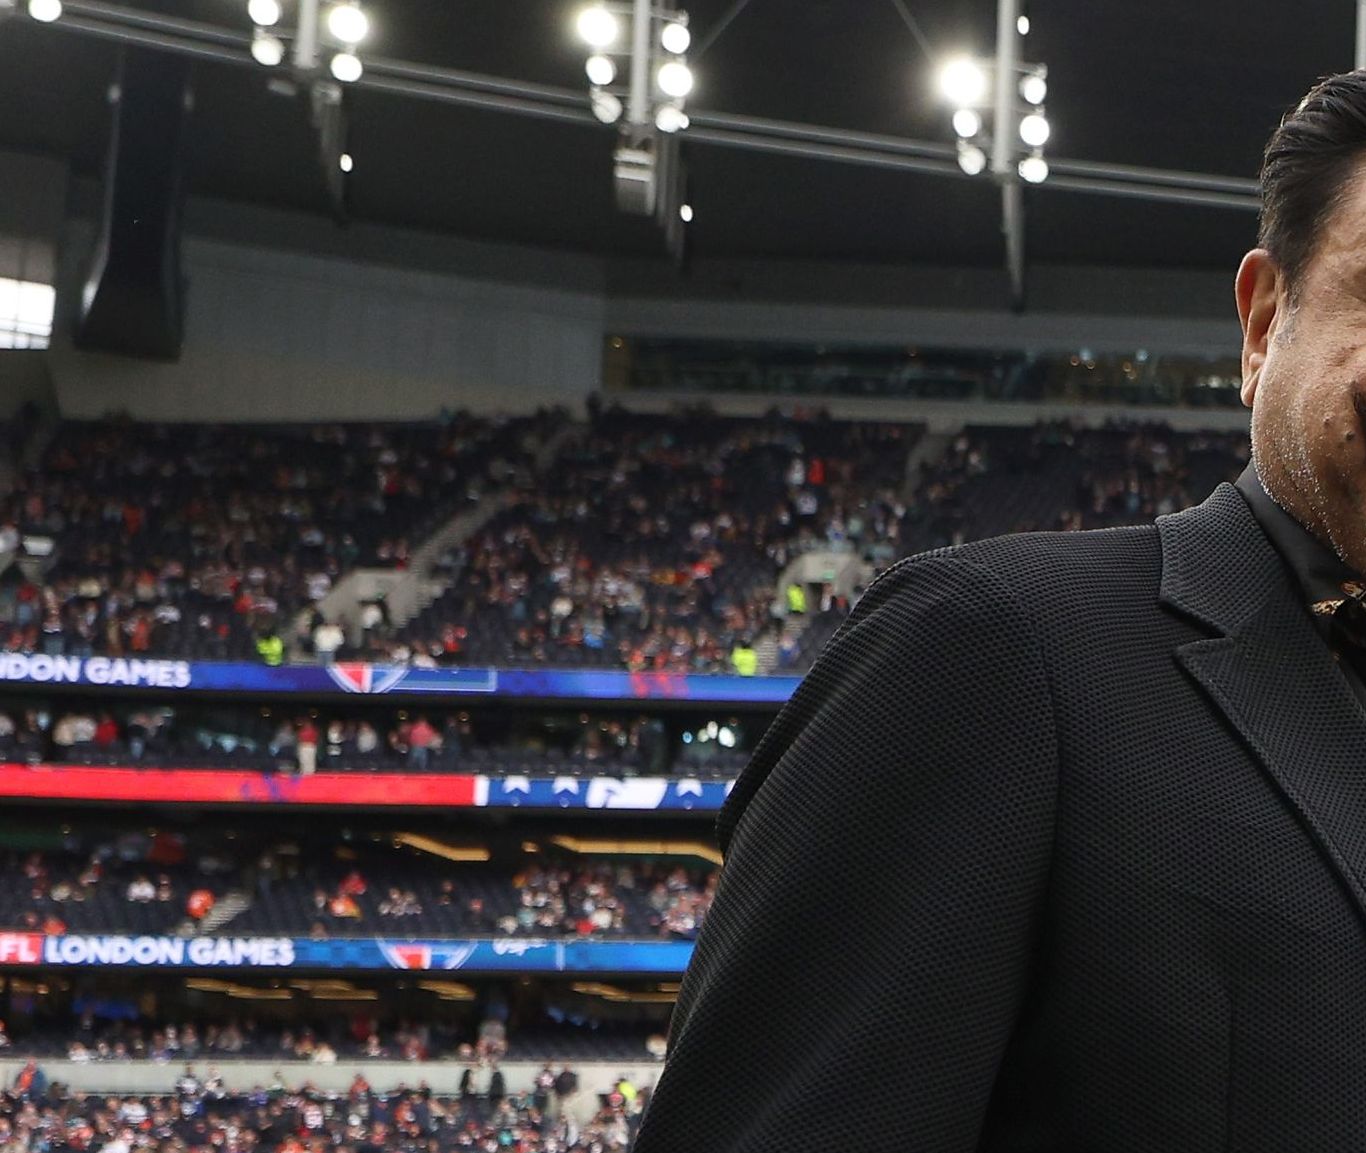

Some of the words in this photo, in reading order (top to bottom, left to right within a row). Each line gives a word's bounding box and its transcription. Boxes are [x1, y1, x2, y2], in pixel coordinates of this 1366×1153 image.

[0, 653, 80, 682] DON
[85, 656, 192, 688] GAMES
[44, 934, 184, 965] LONDON
[188, 936, 295, 966] GAMES
